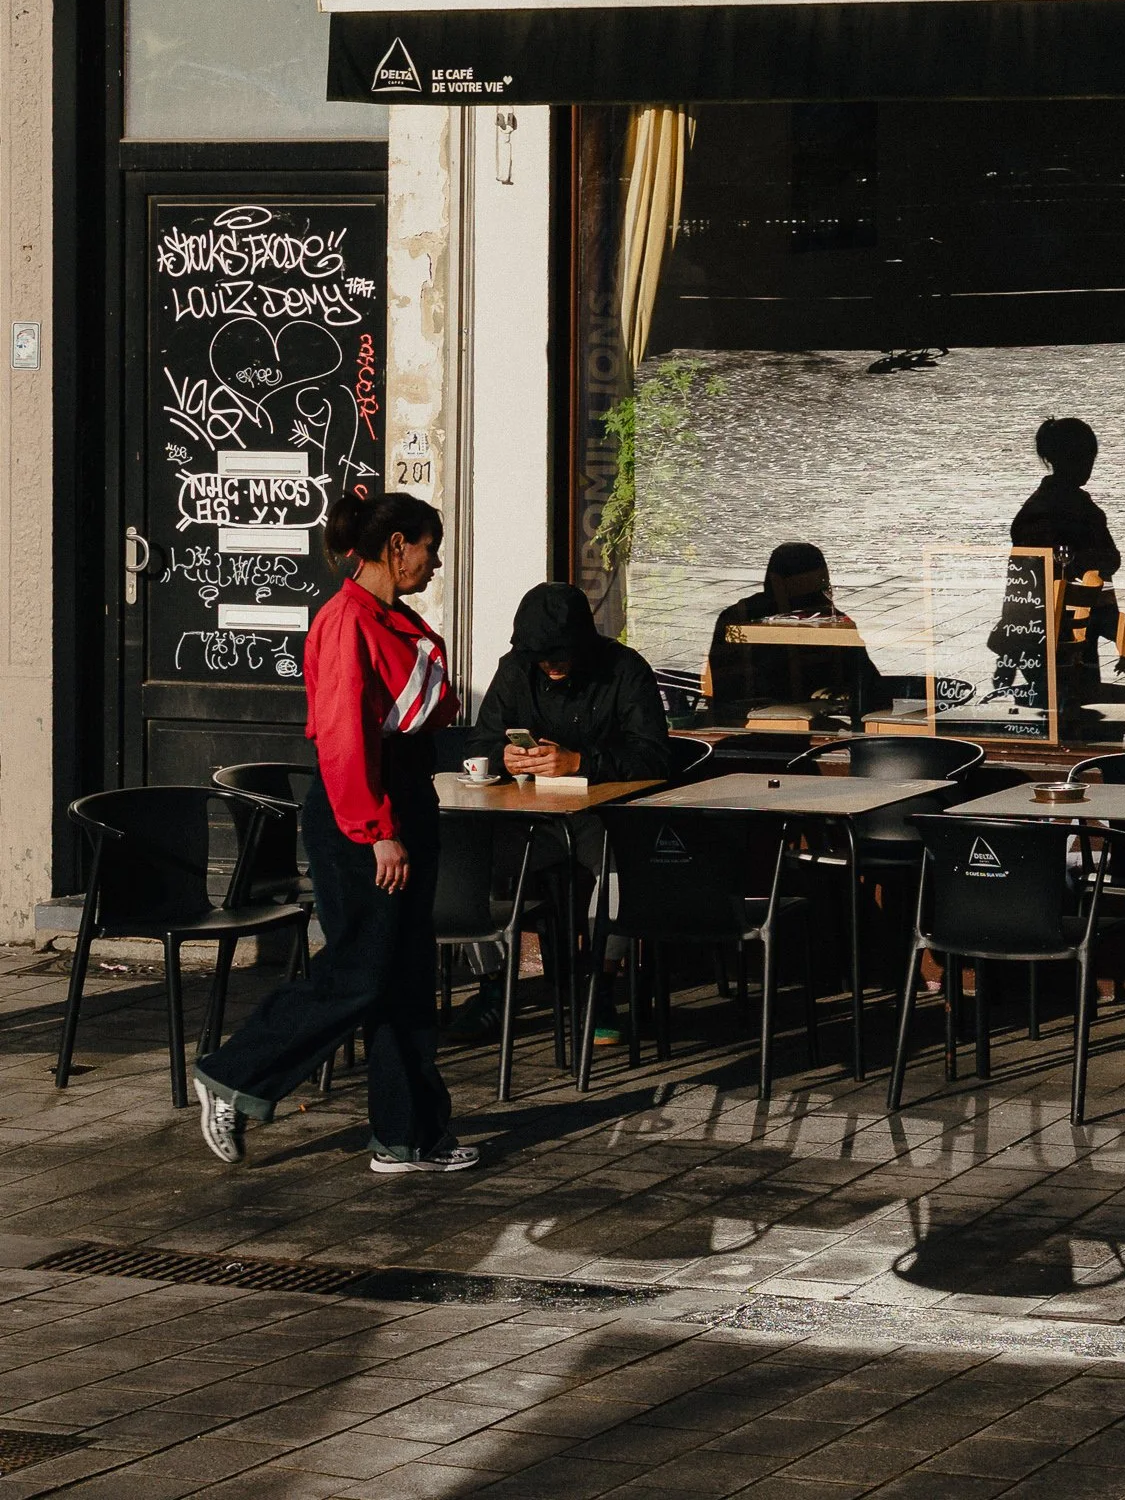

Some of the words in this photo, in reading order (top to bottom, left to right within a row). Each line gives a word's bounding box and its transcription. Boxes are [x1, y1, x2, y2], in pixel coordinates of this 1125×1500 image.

[380, 69, 414, 80] DELTA
[432, 69, 444, 80] LE
[445, 67, 473, 80] CAFÉ
[432, 83, 446, 93] DE
[448, 82, 482, 92] VOTRE
[484, 82, 504, 92] VIE
[396, 460, 432, 485] 201
[1005, 723, 1041, 735] merci
[973, 852, 994, 860] DELTA
